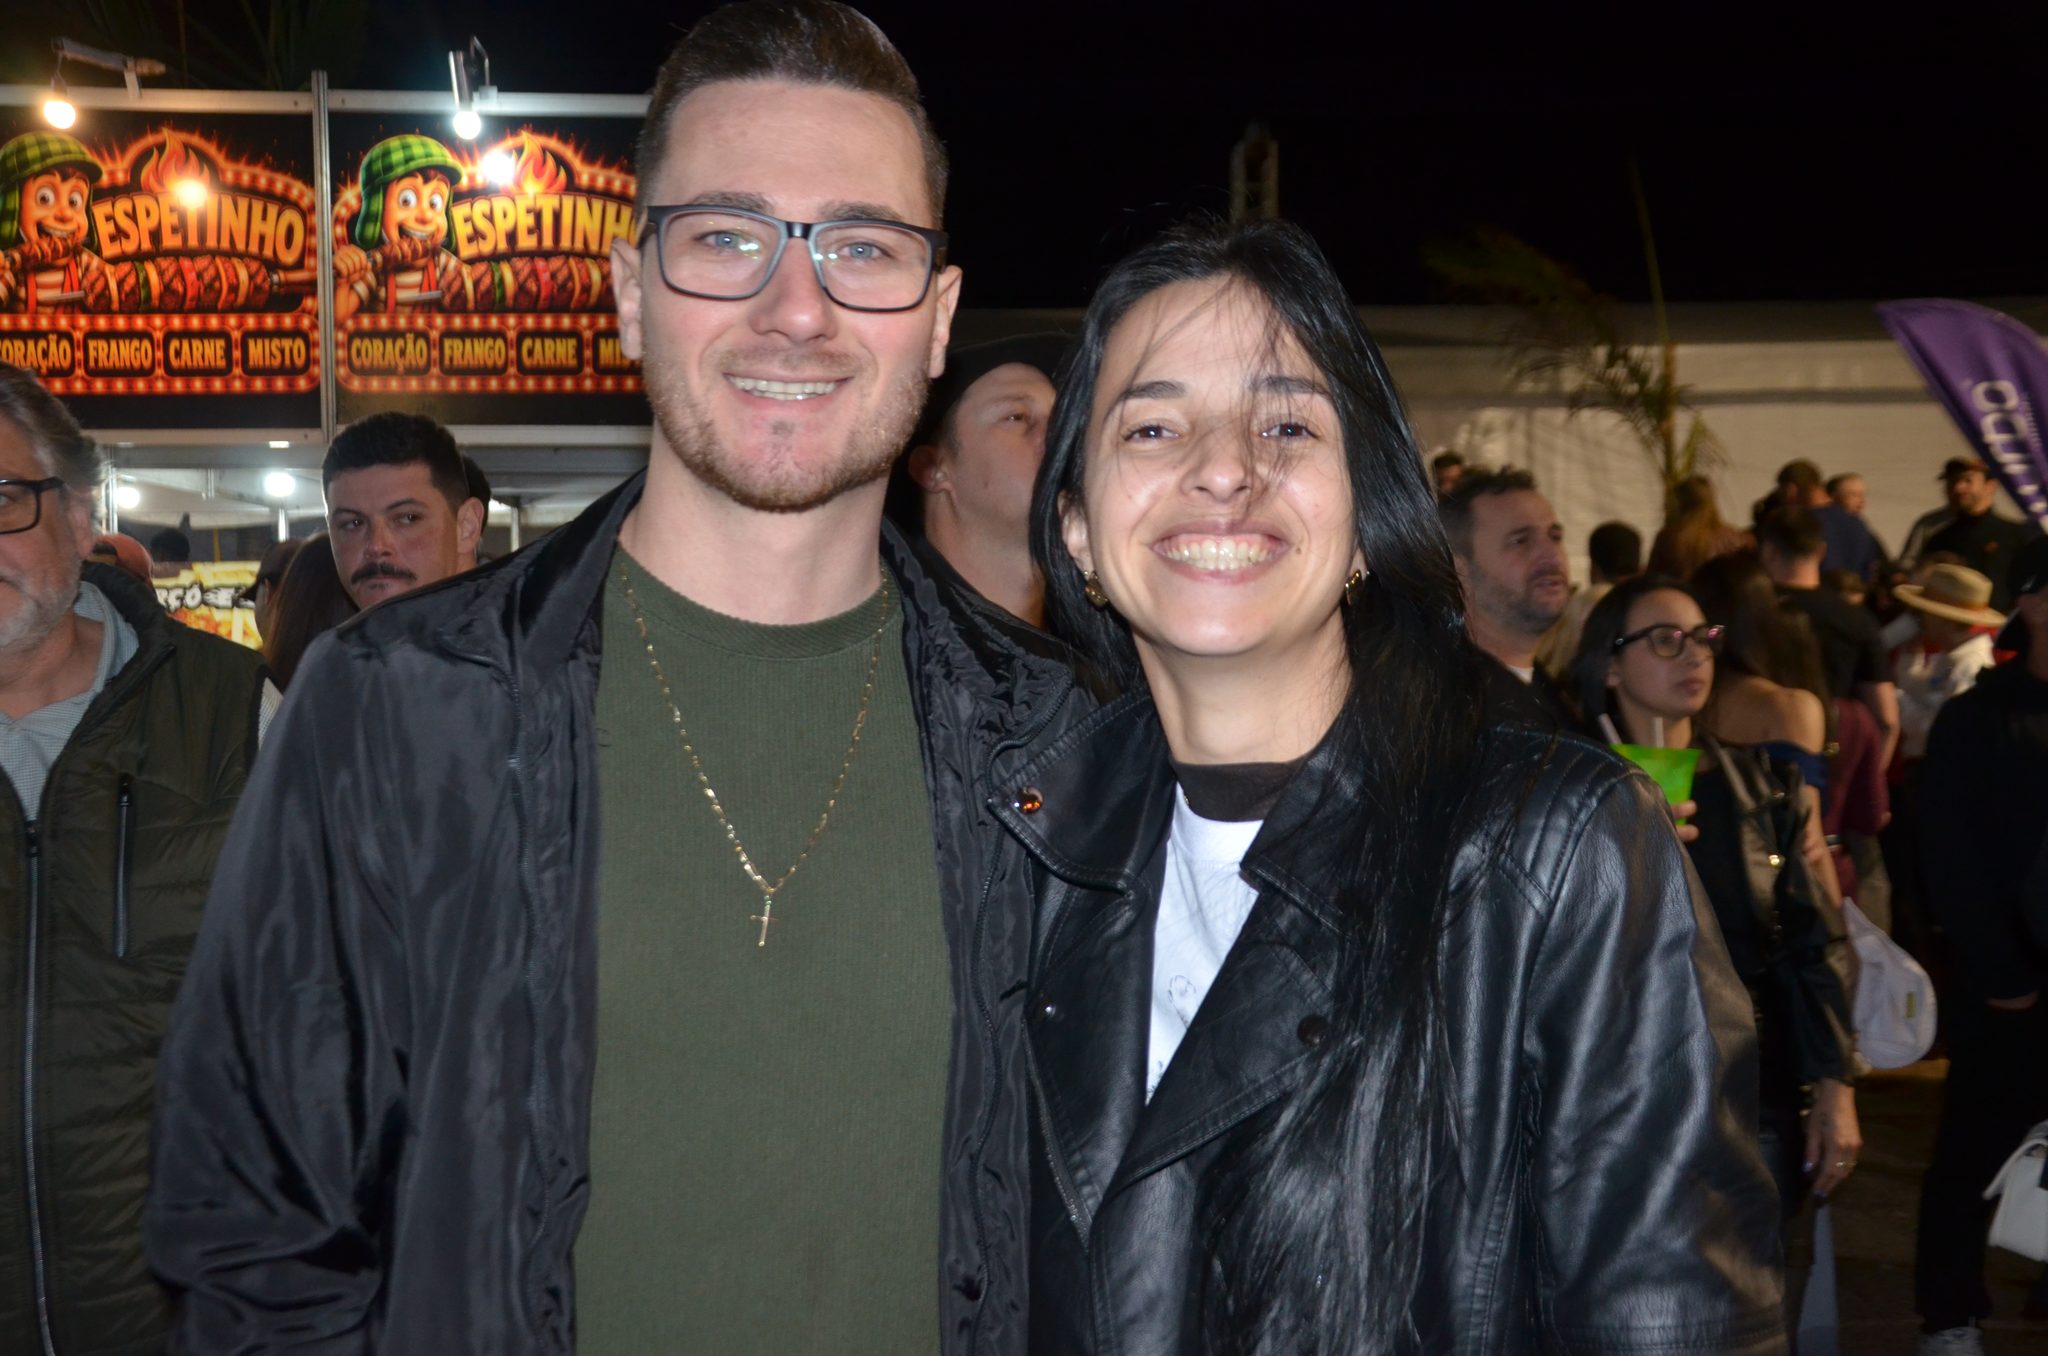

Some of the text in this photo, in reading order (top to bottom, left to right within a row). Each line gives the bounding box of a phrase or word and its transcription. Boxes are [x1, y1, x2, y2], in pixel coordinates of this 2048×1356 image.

[92, 193, 305, 267] ESPETINHO
[451, 193, 638, 260] ESPETINH
[0, 333, 72, 375] ORAÇÃO
[88, 338, 153, 369] FRANGO
[169, 338, 226, 369] CARNE
[248, 337, 307, 369] MISTO
[351, 332, 428, 374] CORAÇÃO
[443, 337, 506, 367] FRANGO
[521, 337, 578, 367] CARNE
